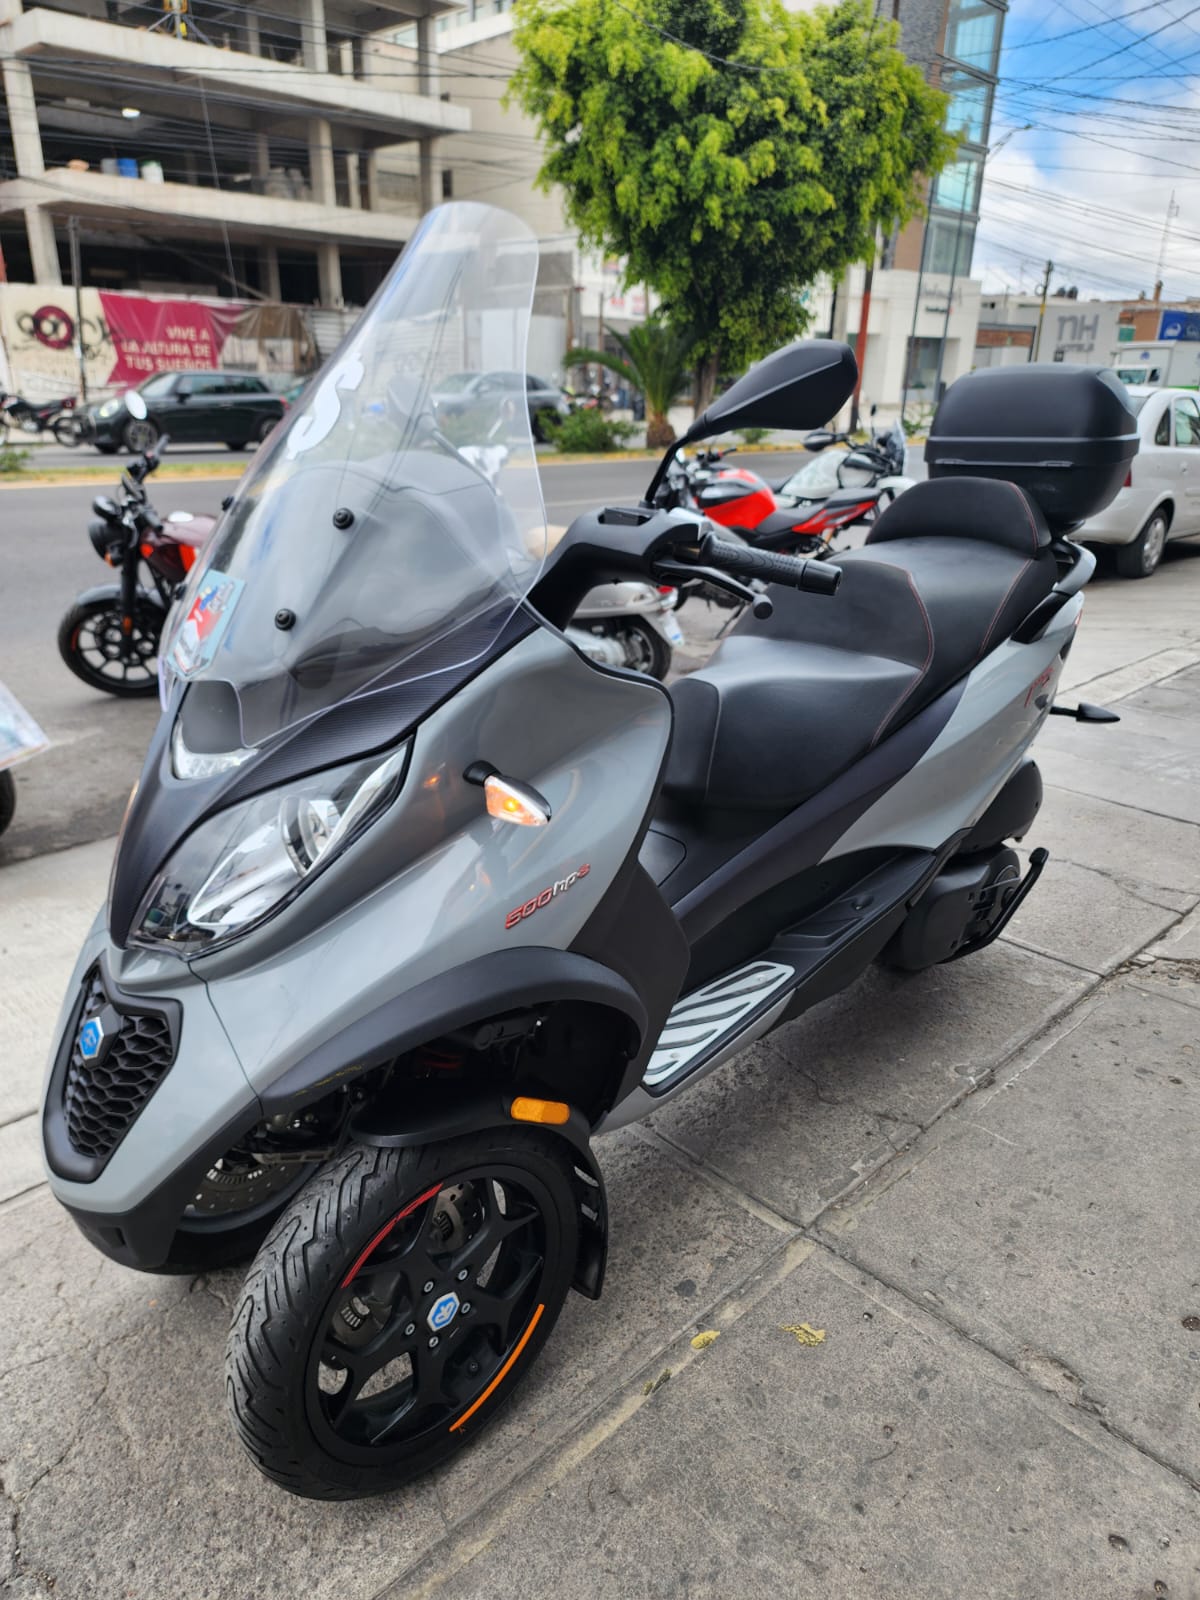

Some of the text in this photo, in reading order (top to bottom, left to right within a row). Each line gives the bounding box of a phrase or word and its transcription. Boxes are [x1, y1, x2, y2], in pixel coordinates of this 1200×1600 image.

[166, 325, 210, 341] VIVE A
[121, 340, 211, 357] LA ALTURA DE
[125, 355, 154, 371] TUS
